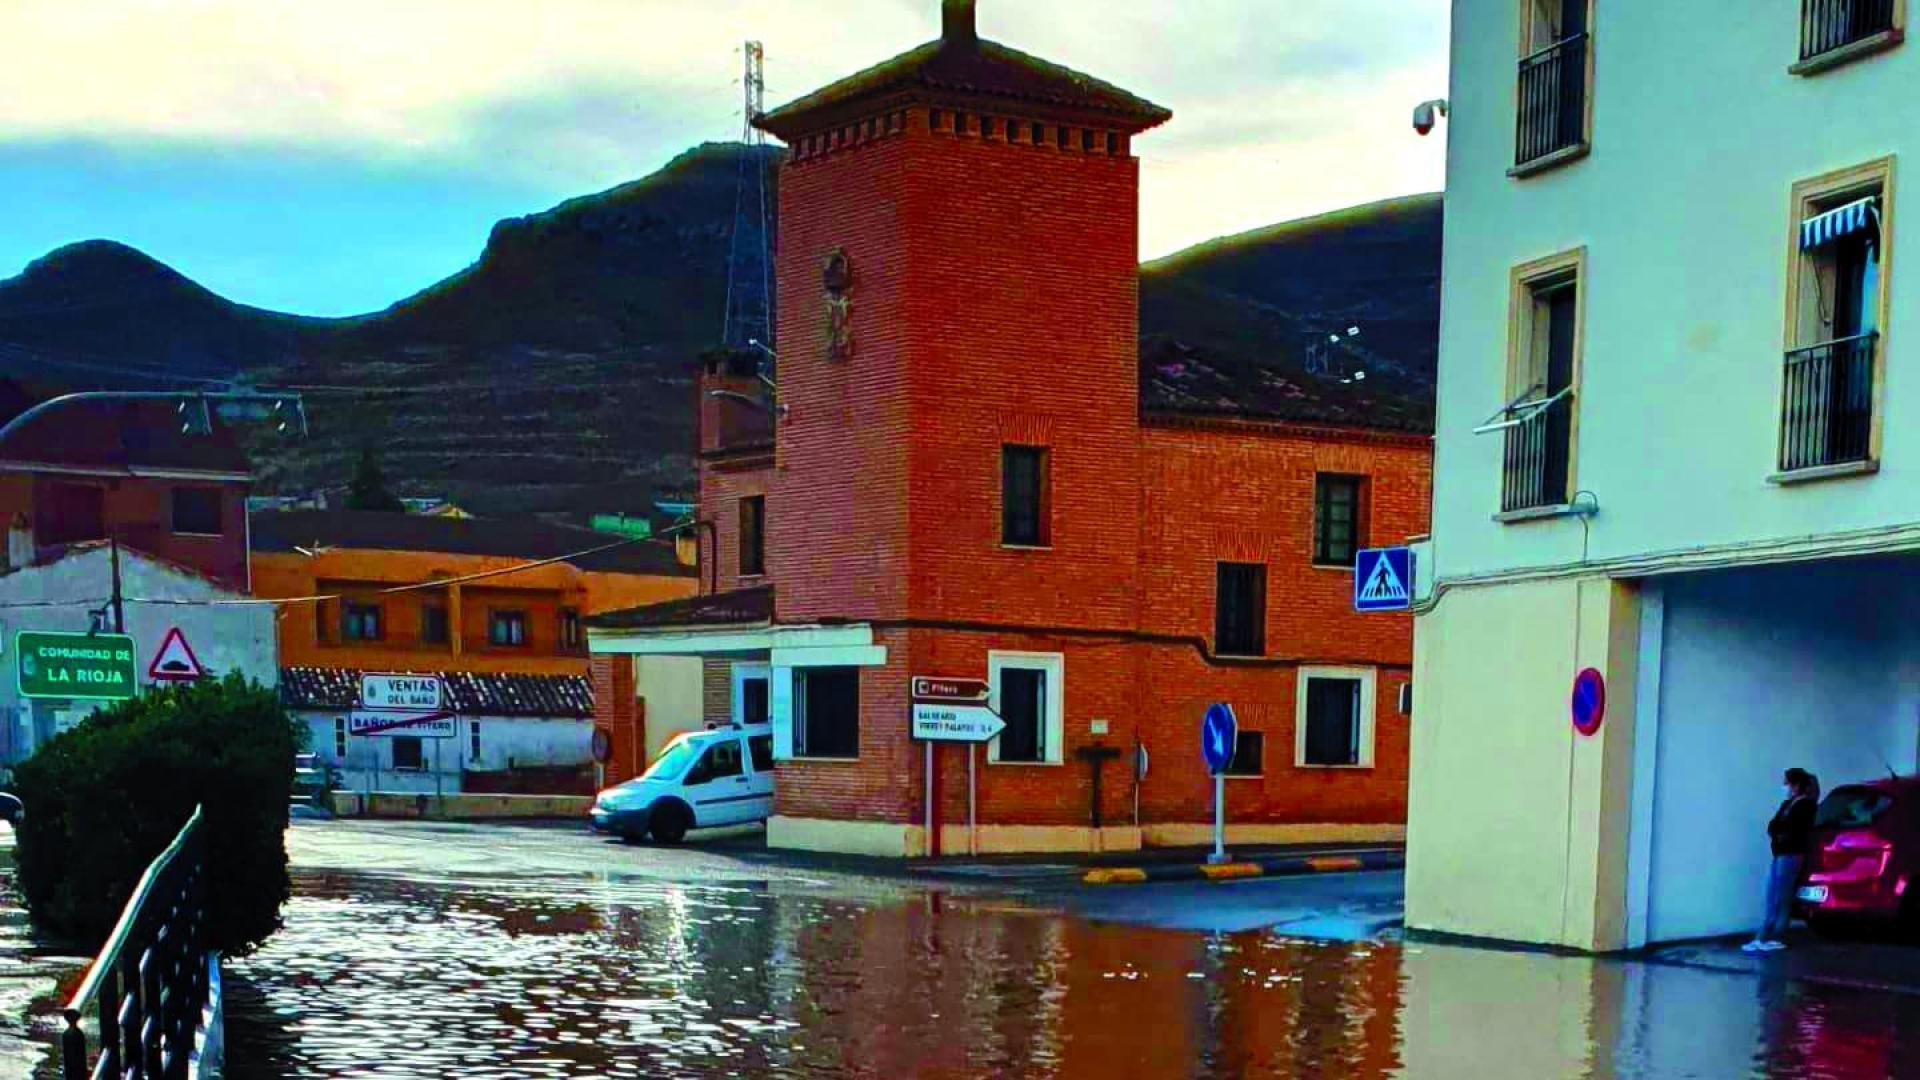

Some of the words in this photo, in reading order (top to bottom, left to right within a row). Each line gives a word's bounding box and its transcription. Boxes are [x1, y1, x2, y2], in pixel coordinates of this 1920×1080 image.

[39, 647, 111, 660] COMUNIDAD
[116, 649, 130, 661] DE
[47, 668, 70, 683] LA
[77, 669, 123, 684] RIOJA
[387, 679, 436, 692] VENTAS
[387, 695, 405, 704] DEL
